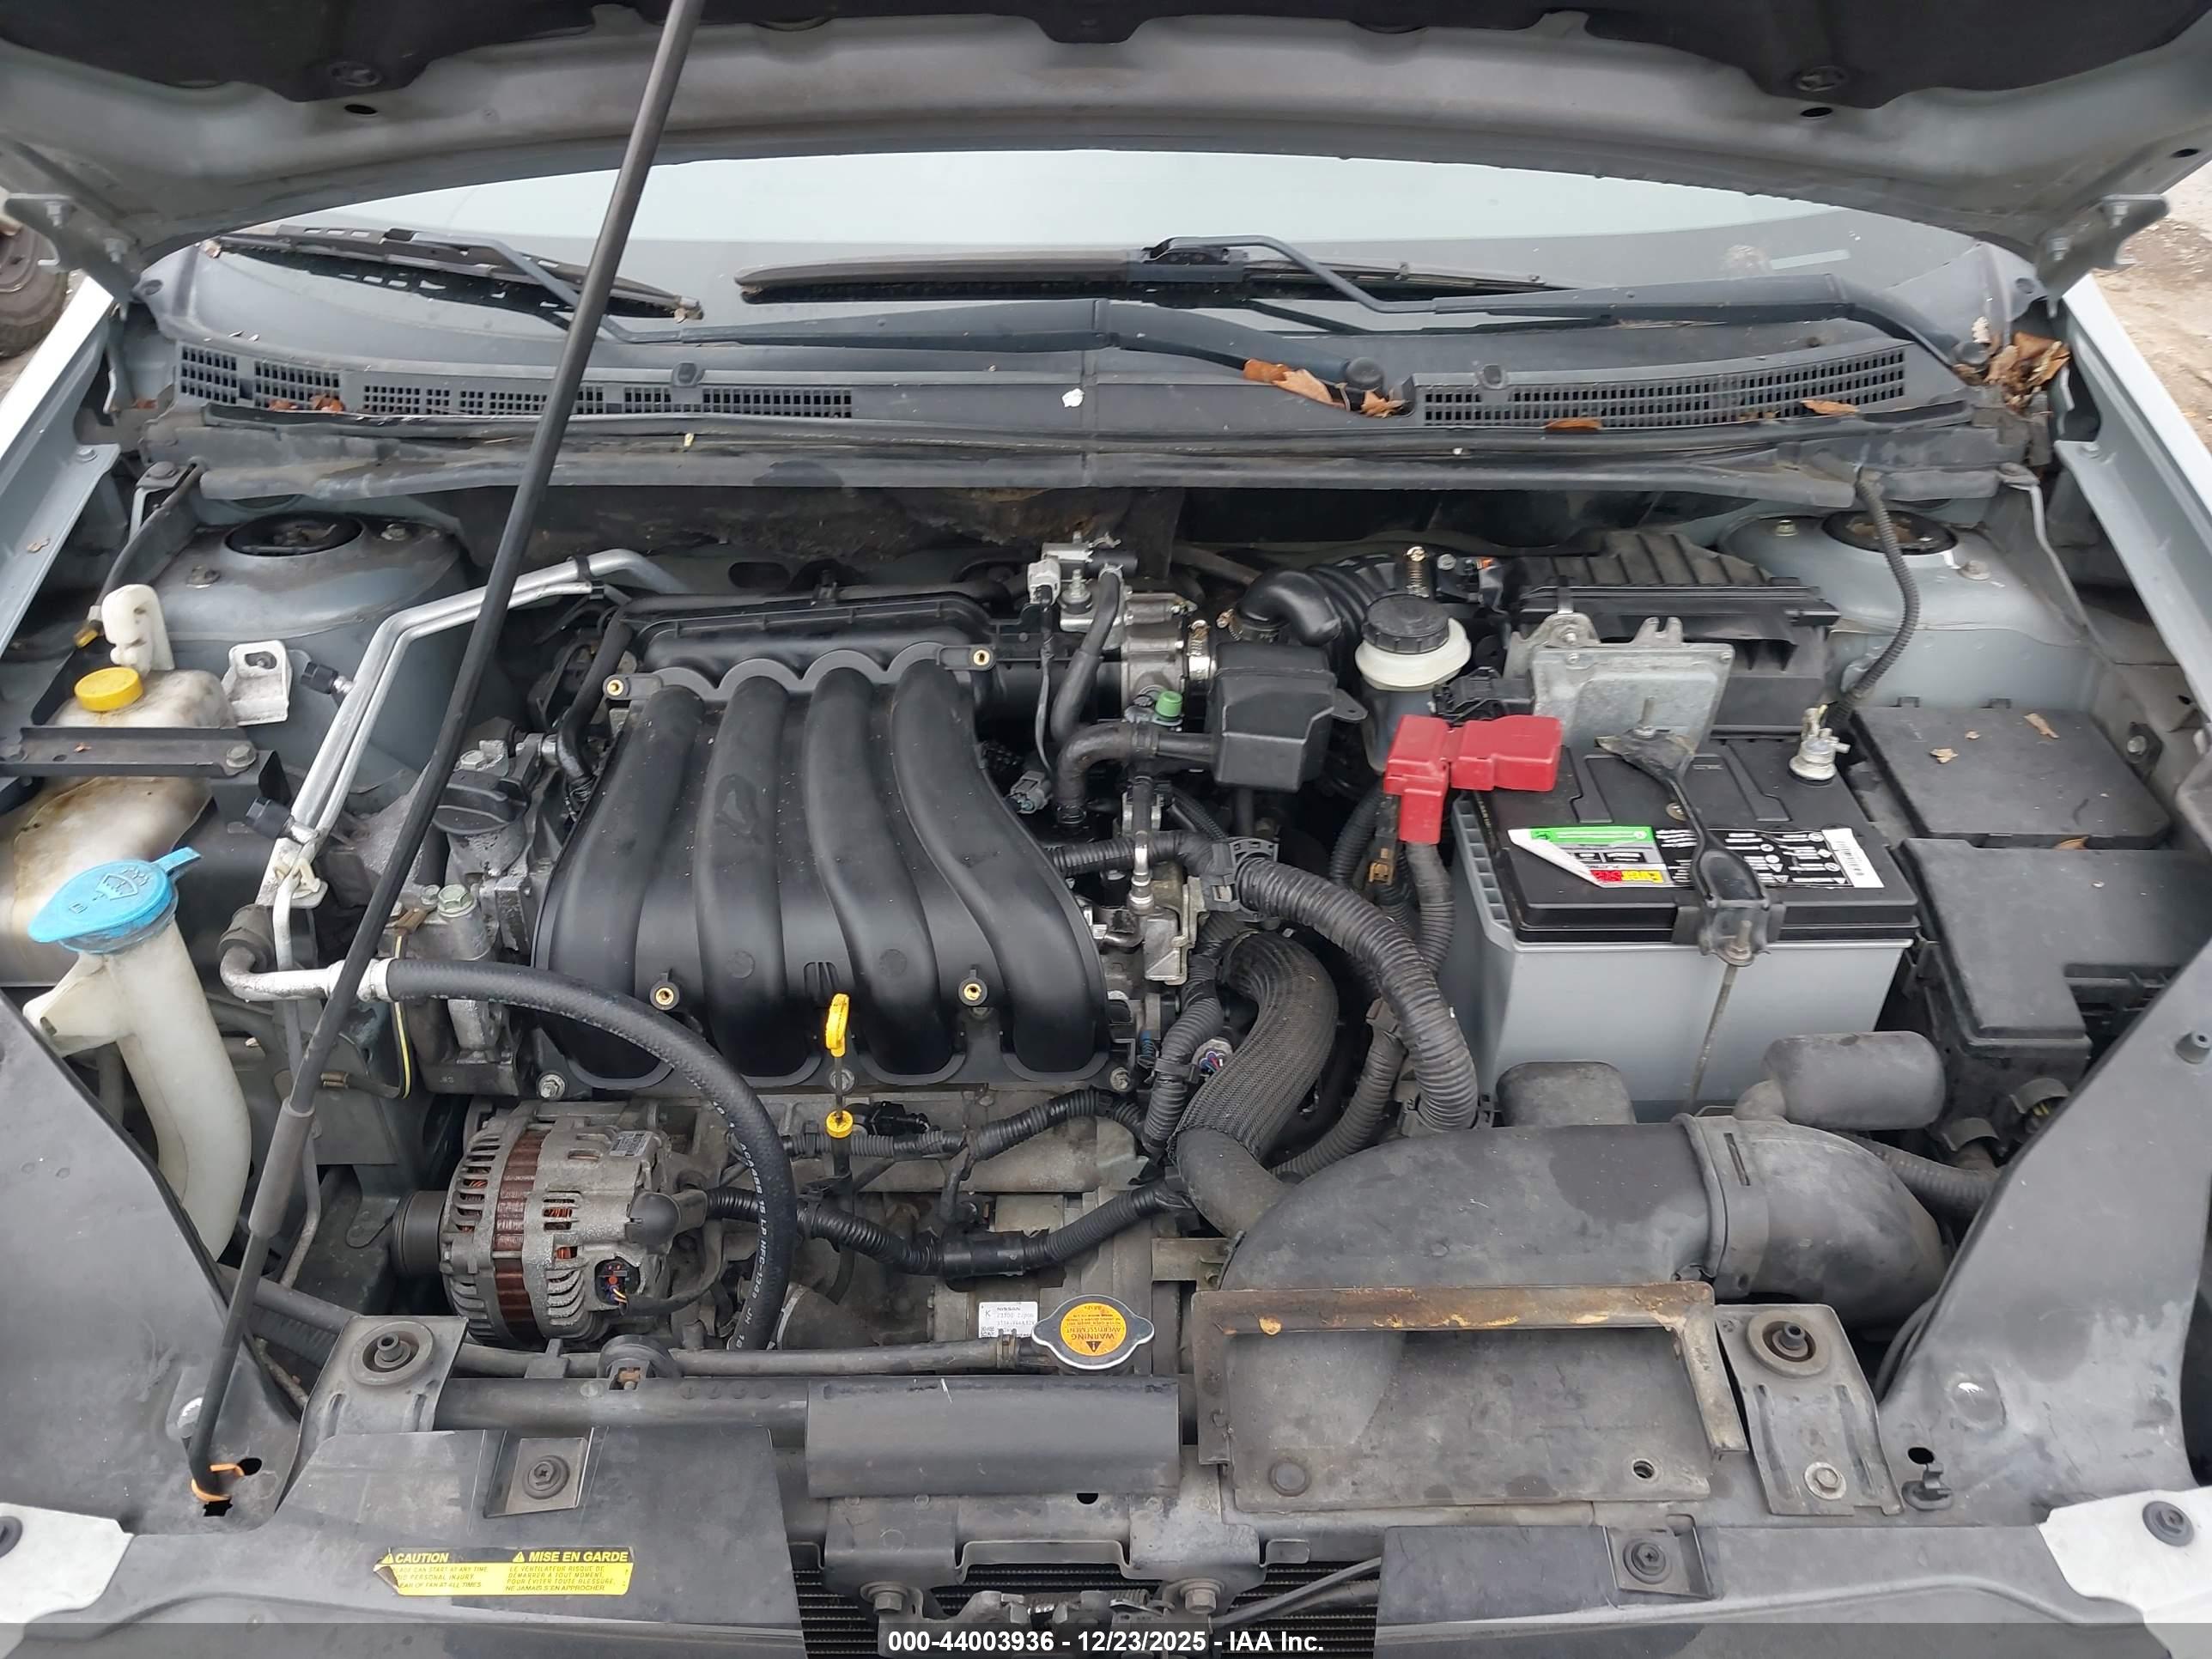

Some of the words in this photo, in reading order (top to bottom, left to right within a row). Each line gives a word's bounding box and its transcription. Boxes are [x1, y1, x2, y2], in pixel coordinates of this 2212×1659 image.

[760, 1218, 767, 1236] LP
[744, 1307, 753, 1324] JH
[395, 1552, 449, 1563] CAUTION
[528, 1552, 560, 1562] MISE
[562, 1552, 581, 1562] EN
[583, 1552, 629, 1562] GARDE
